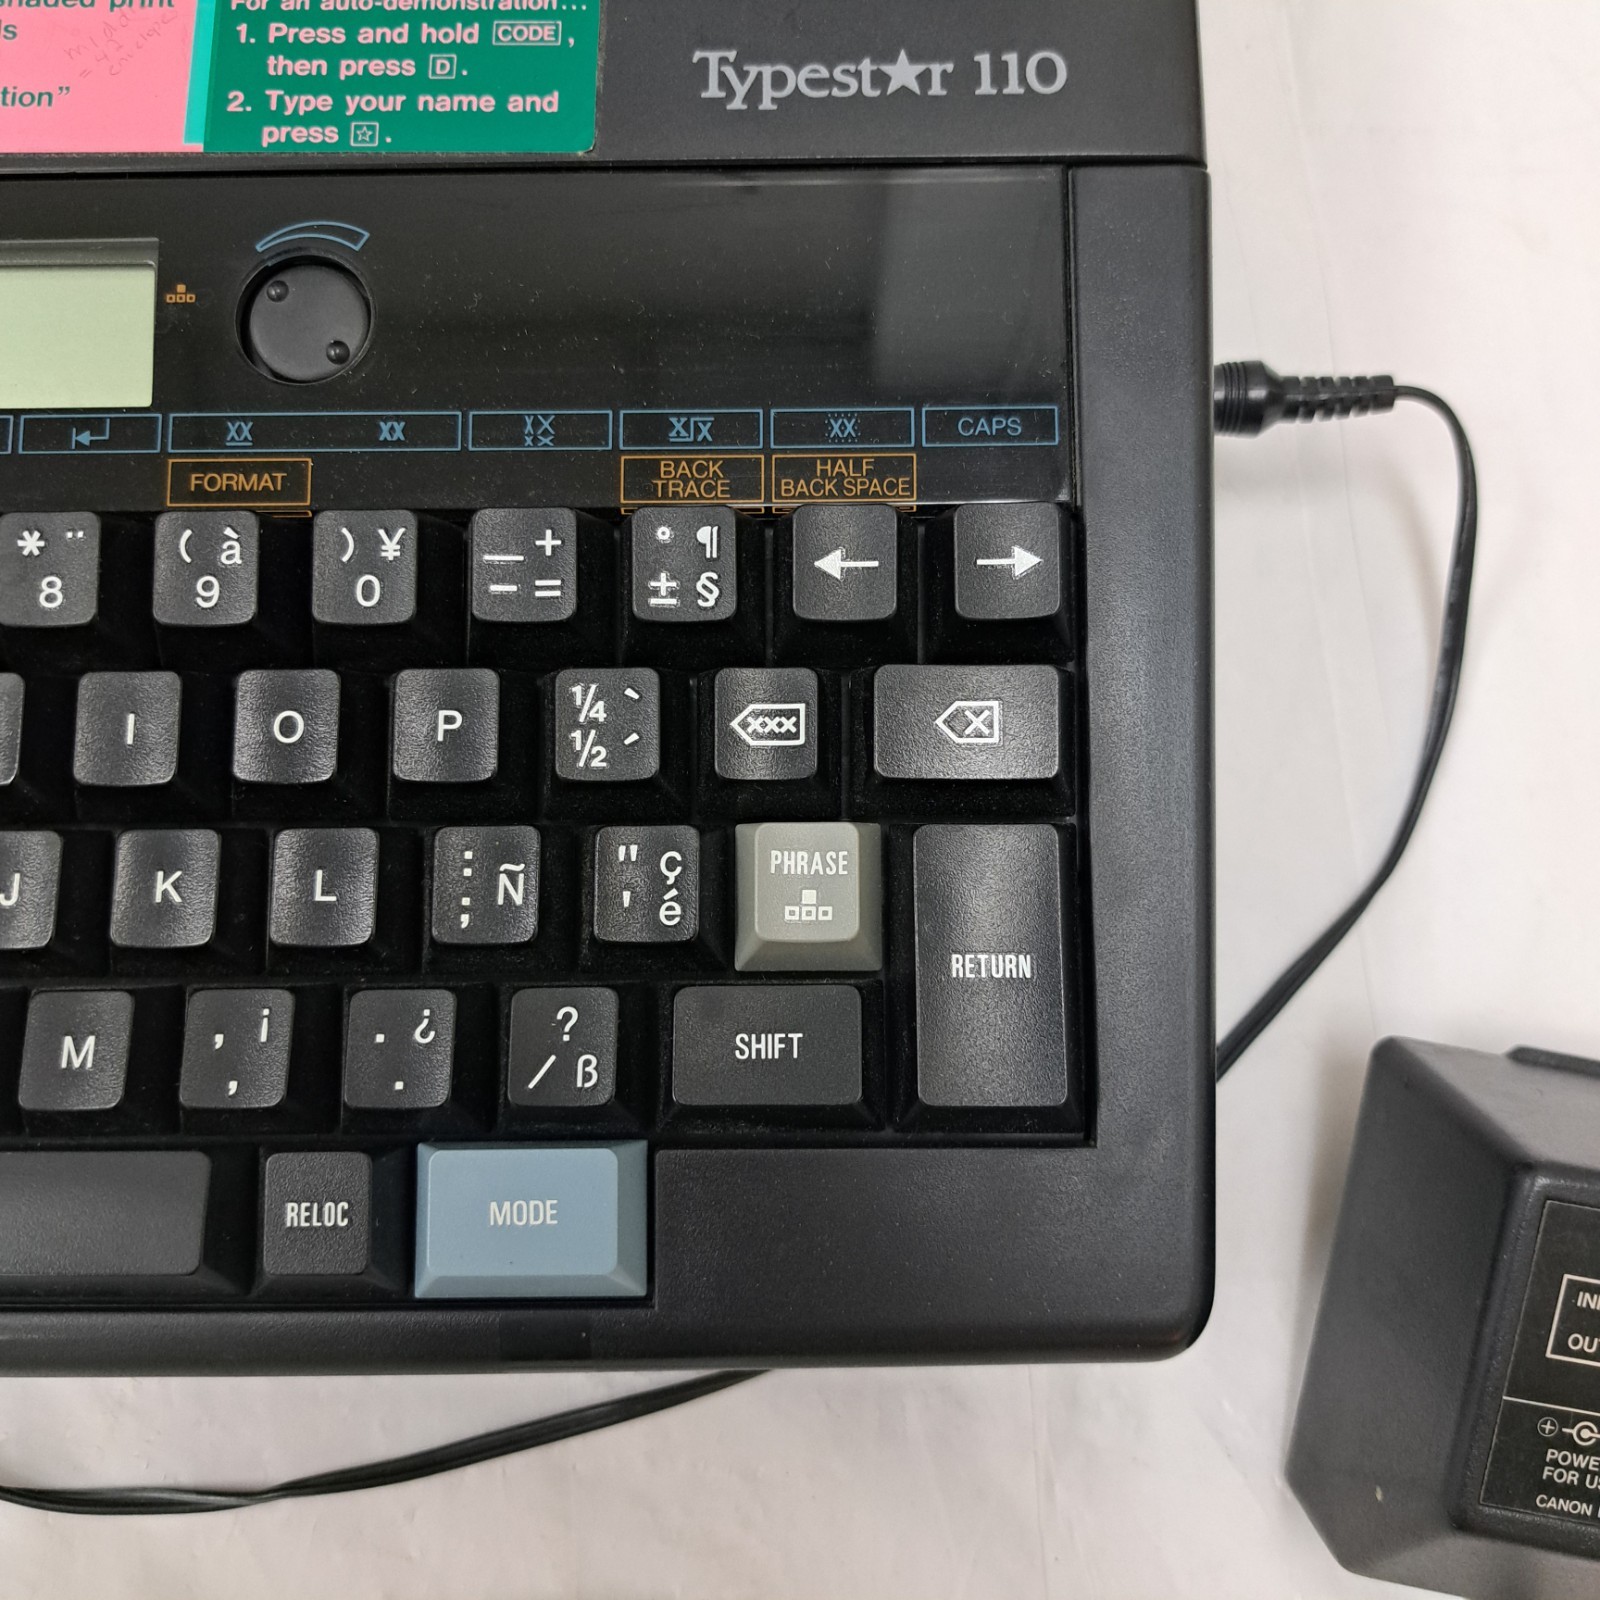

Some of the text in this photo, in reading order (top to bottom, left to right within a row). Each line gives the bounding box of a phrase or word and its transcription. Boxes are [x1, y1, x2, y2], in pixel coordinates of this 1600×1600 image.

[280, 0, 310, 10] an
[0, 19, 17, 40] s
[237, 23, 256, 44] 1.
[268, 23, 346, 44] Press
[357, 23, 410, 44] and
[421, 23, 480, 44] hold
[267, 55, 328, 76] then
[340, 59, 416, 80] press
[973, 50, 1068, 95] 110
[226, 89, 560, 116] 2. Type your name and
[262, 126, 339, 148] press
[957, 416, 1023, 437] CAPS
[660, 460, 724, 479] BACK
[816, 458, 875, 477] HALF
[190, 472, 288, 493] FORMAT
[653, 479, 731, 499] TRACE
[781, 477, 911, 498] BACK SPACE
[38, 575, 64, 610] 8
[195, 575, 220, 609] 9
[437, 709, 463, 742] P
[770, 850, 849, 877] PHRASE
[0, 872, 21, 907] J
[154, 870, 183, 903] K
[314, 869, 337, 902] L
[497, 863, 526, 906] Ñ
[950, 952, 1032, 981] RETURN
[60, 1035, 96, 1070] M
[734, 1032, 804, 1060] SHIFT
[285, 1201, 349, 1228] RELOC
[490, 1199, 558, 1226] MODE
[1567, 1333, 1600, 1353] OU
[1545, 1448, 1600, 1471] POWE
[1542, 1466, 1600, 1490] FOR U
[1535, 1494, 1593, 1517] CANON
